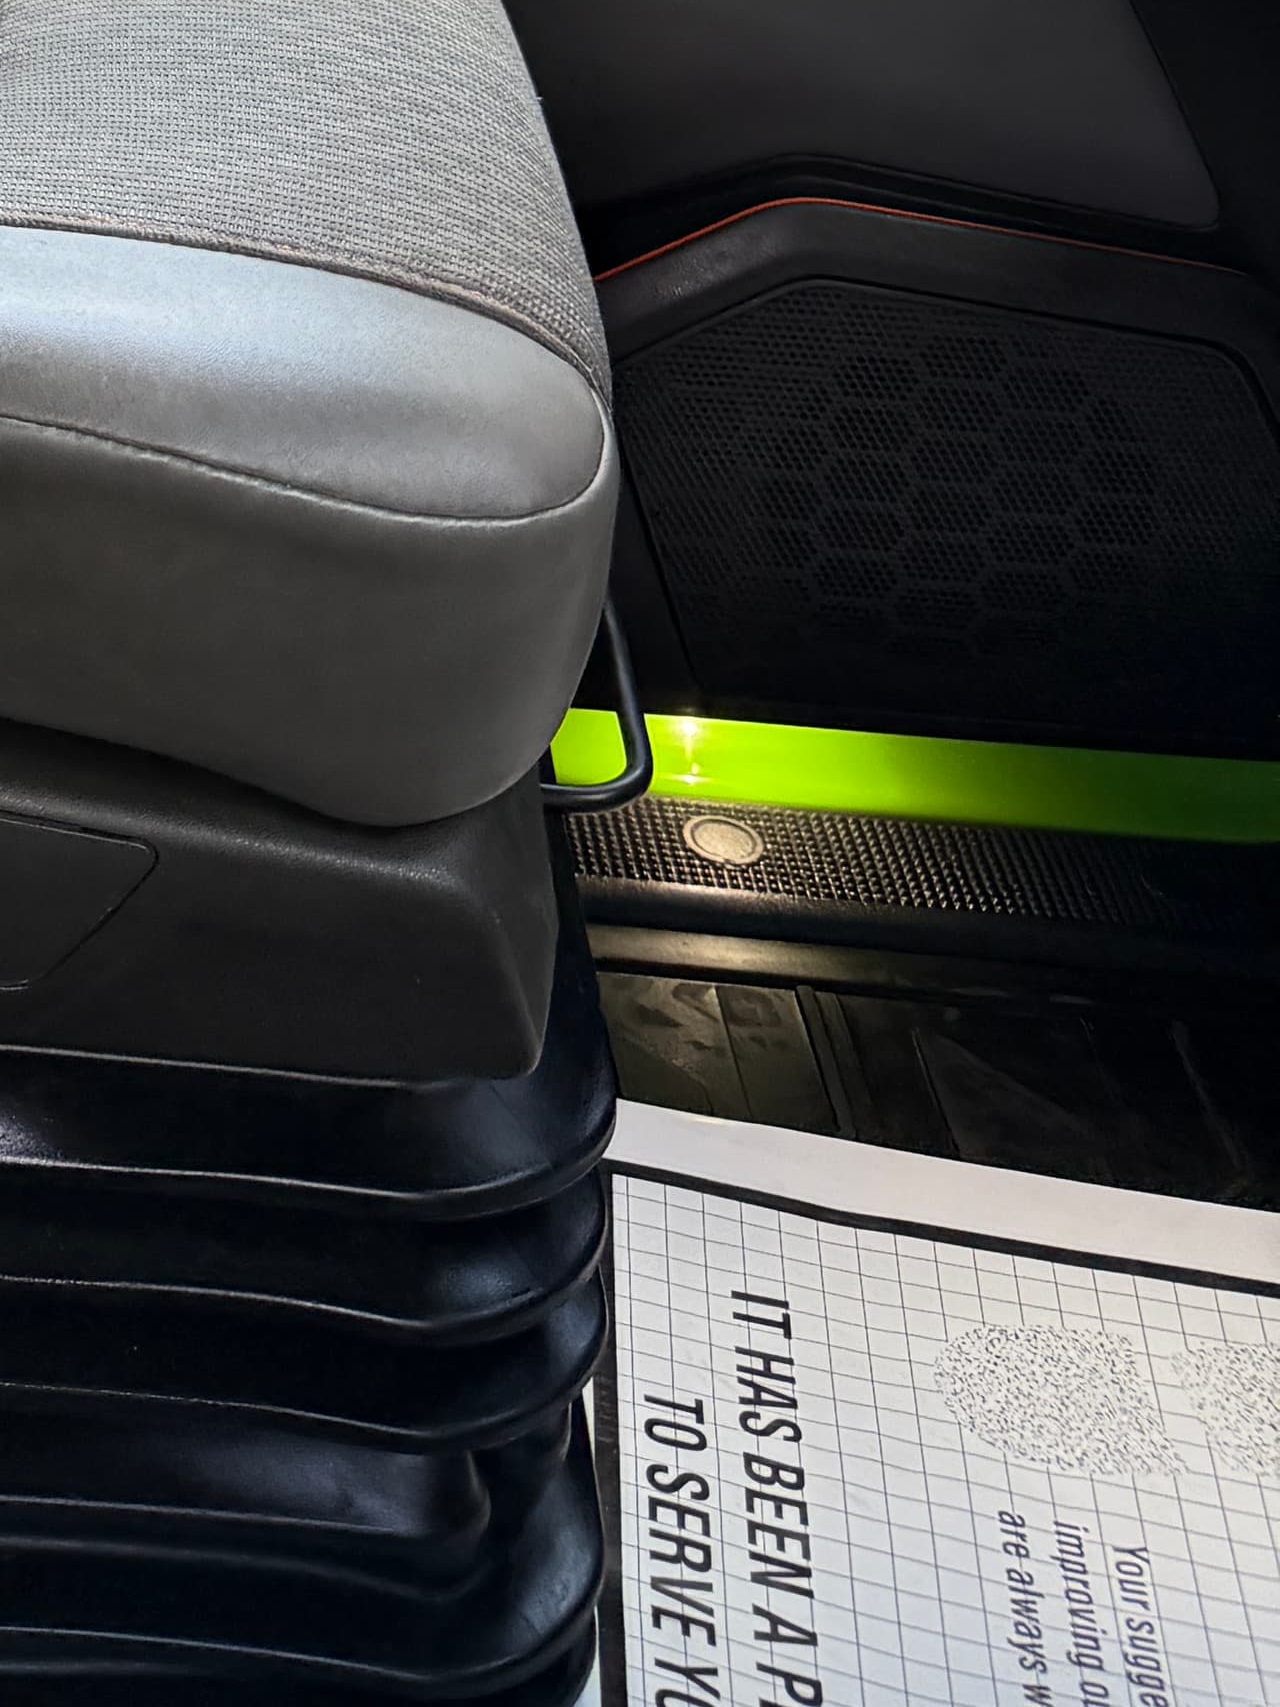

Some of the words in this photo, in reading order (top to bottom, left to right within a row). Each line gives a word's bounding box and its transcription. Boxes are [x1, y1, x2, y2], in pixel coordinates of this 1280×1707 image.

[731, 1290, 792, 1339] IT
[644, 1394, 708, 1452] TO
[735, 1346, 802, 1443] HAS
[646, 1464, 717, 1647] SERVE
[743, 1452, 815, 1599] BEEN
[998, 1510, 1030, 1559] are
[1050, 1520, 1108, 1672] improving
[1112, 1545, 1151, 1612] Your
[752, 1603, 819, 1647] A
[1006, 1567, 1048, 1674] always
